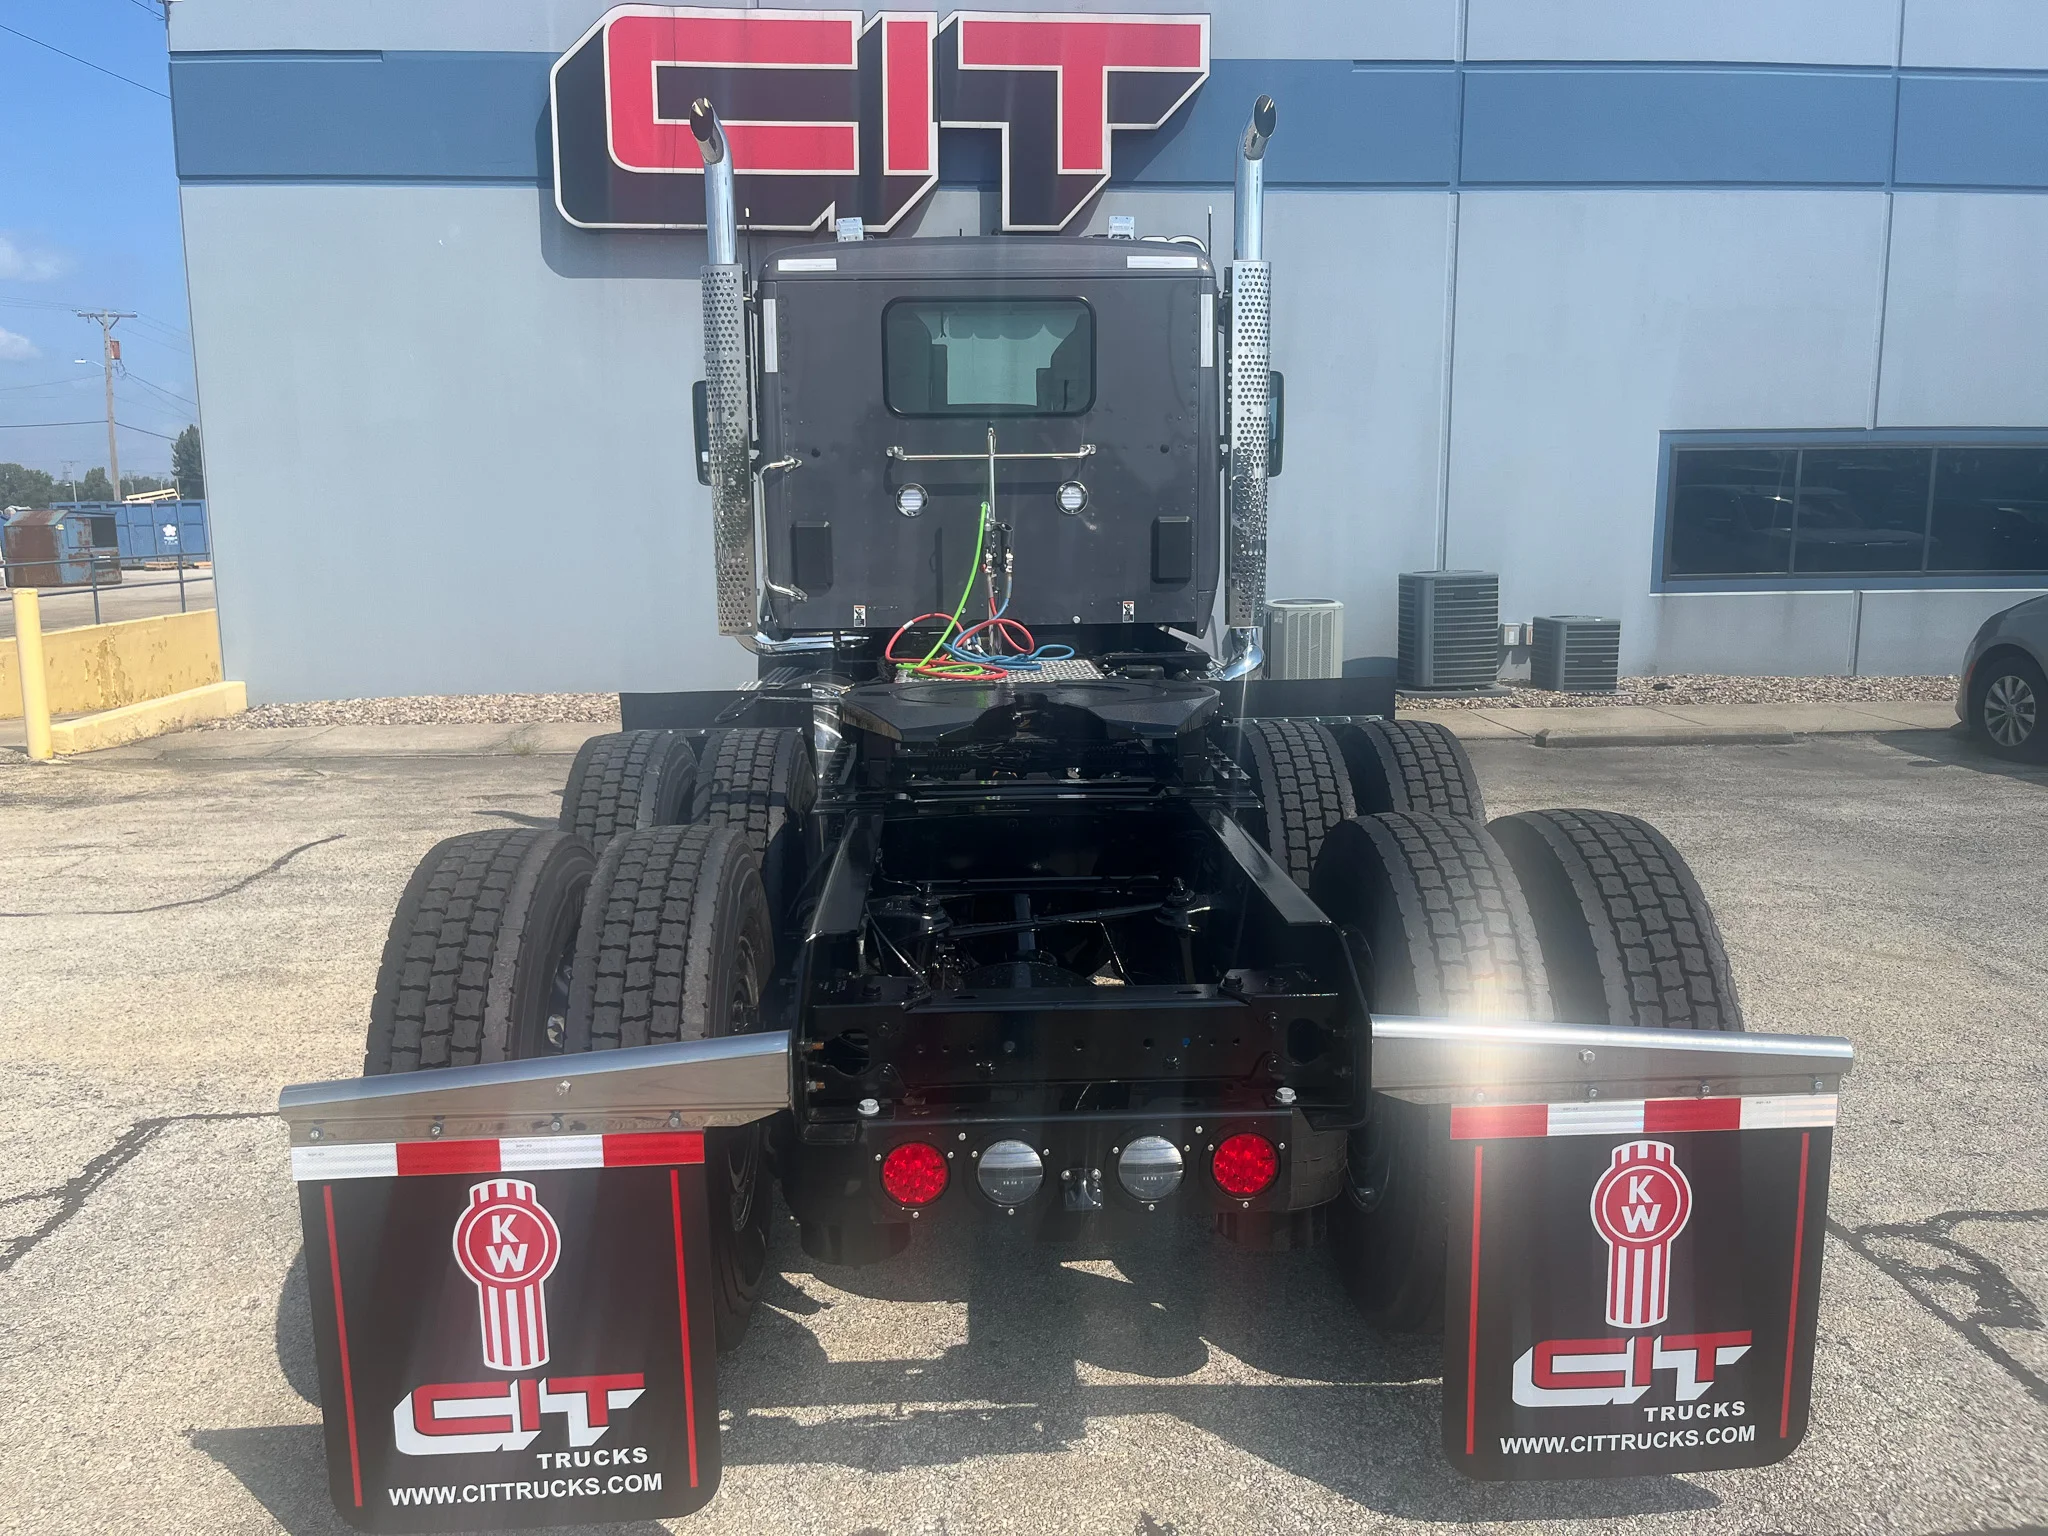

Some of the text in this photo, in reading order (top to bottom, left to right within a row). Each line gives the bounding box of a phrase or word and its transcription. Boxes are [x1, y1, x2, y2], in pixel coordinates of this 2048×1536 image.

[550, 4, 1210, 231] CIT
[1628, 1175, 1655, 1204] K
[491, 1214, 519, 1243] K
[1621, 1204, 1662, 1233] W
[486, 1243, 529, 1273] W
[1513, 1331, 1752, 1407] CIT
[393, 1373, 646, 1455] CIT
[1643, 1401, 1746, 1423] TRUCKS
[1500, 1425, 1756, 1455] WWW.CITTRUCKS.COM
[536, 1447, 648, 1470] TRUCKS
[389, 1473, 663, 1507] WWW.CITTRUCKS.COM
